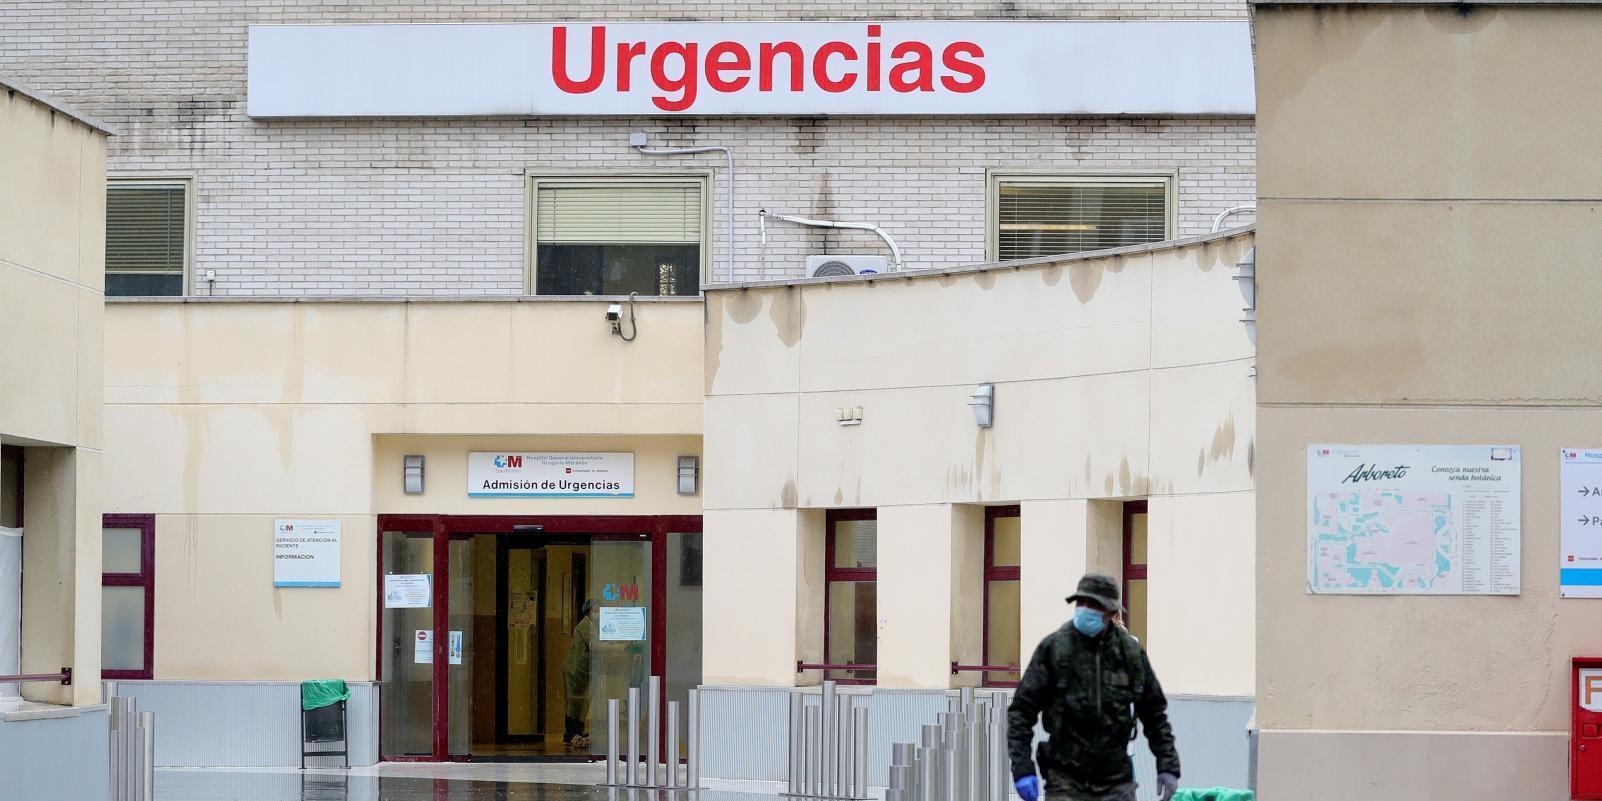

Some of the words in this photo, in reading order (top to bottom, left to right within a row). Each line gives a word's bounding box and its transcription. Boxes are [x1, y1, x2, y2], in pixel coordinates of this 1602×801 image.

[552, 24, 986, 112] Urgencias
[1341, 463, 1411, 484] Arboreto
[1432, 465, 1460, 473] Conozca
[1448, 473, 1469, 481] senda
[483, 479, 538, 490] Admisión
[541, 480, 556, 490] de
[559, 479, 620, 492] Urgencias
[1592, 487, 1602, 496] A
